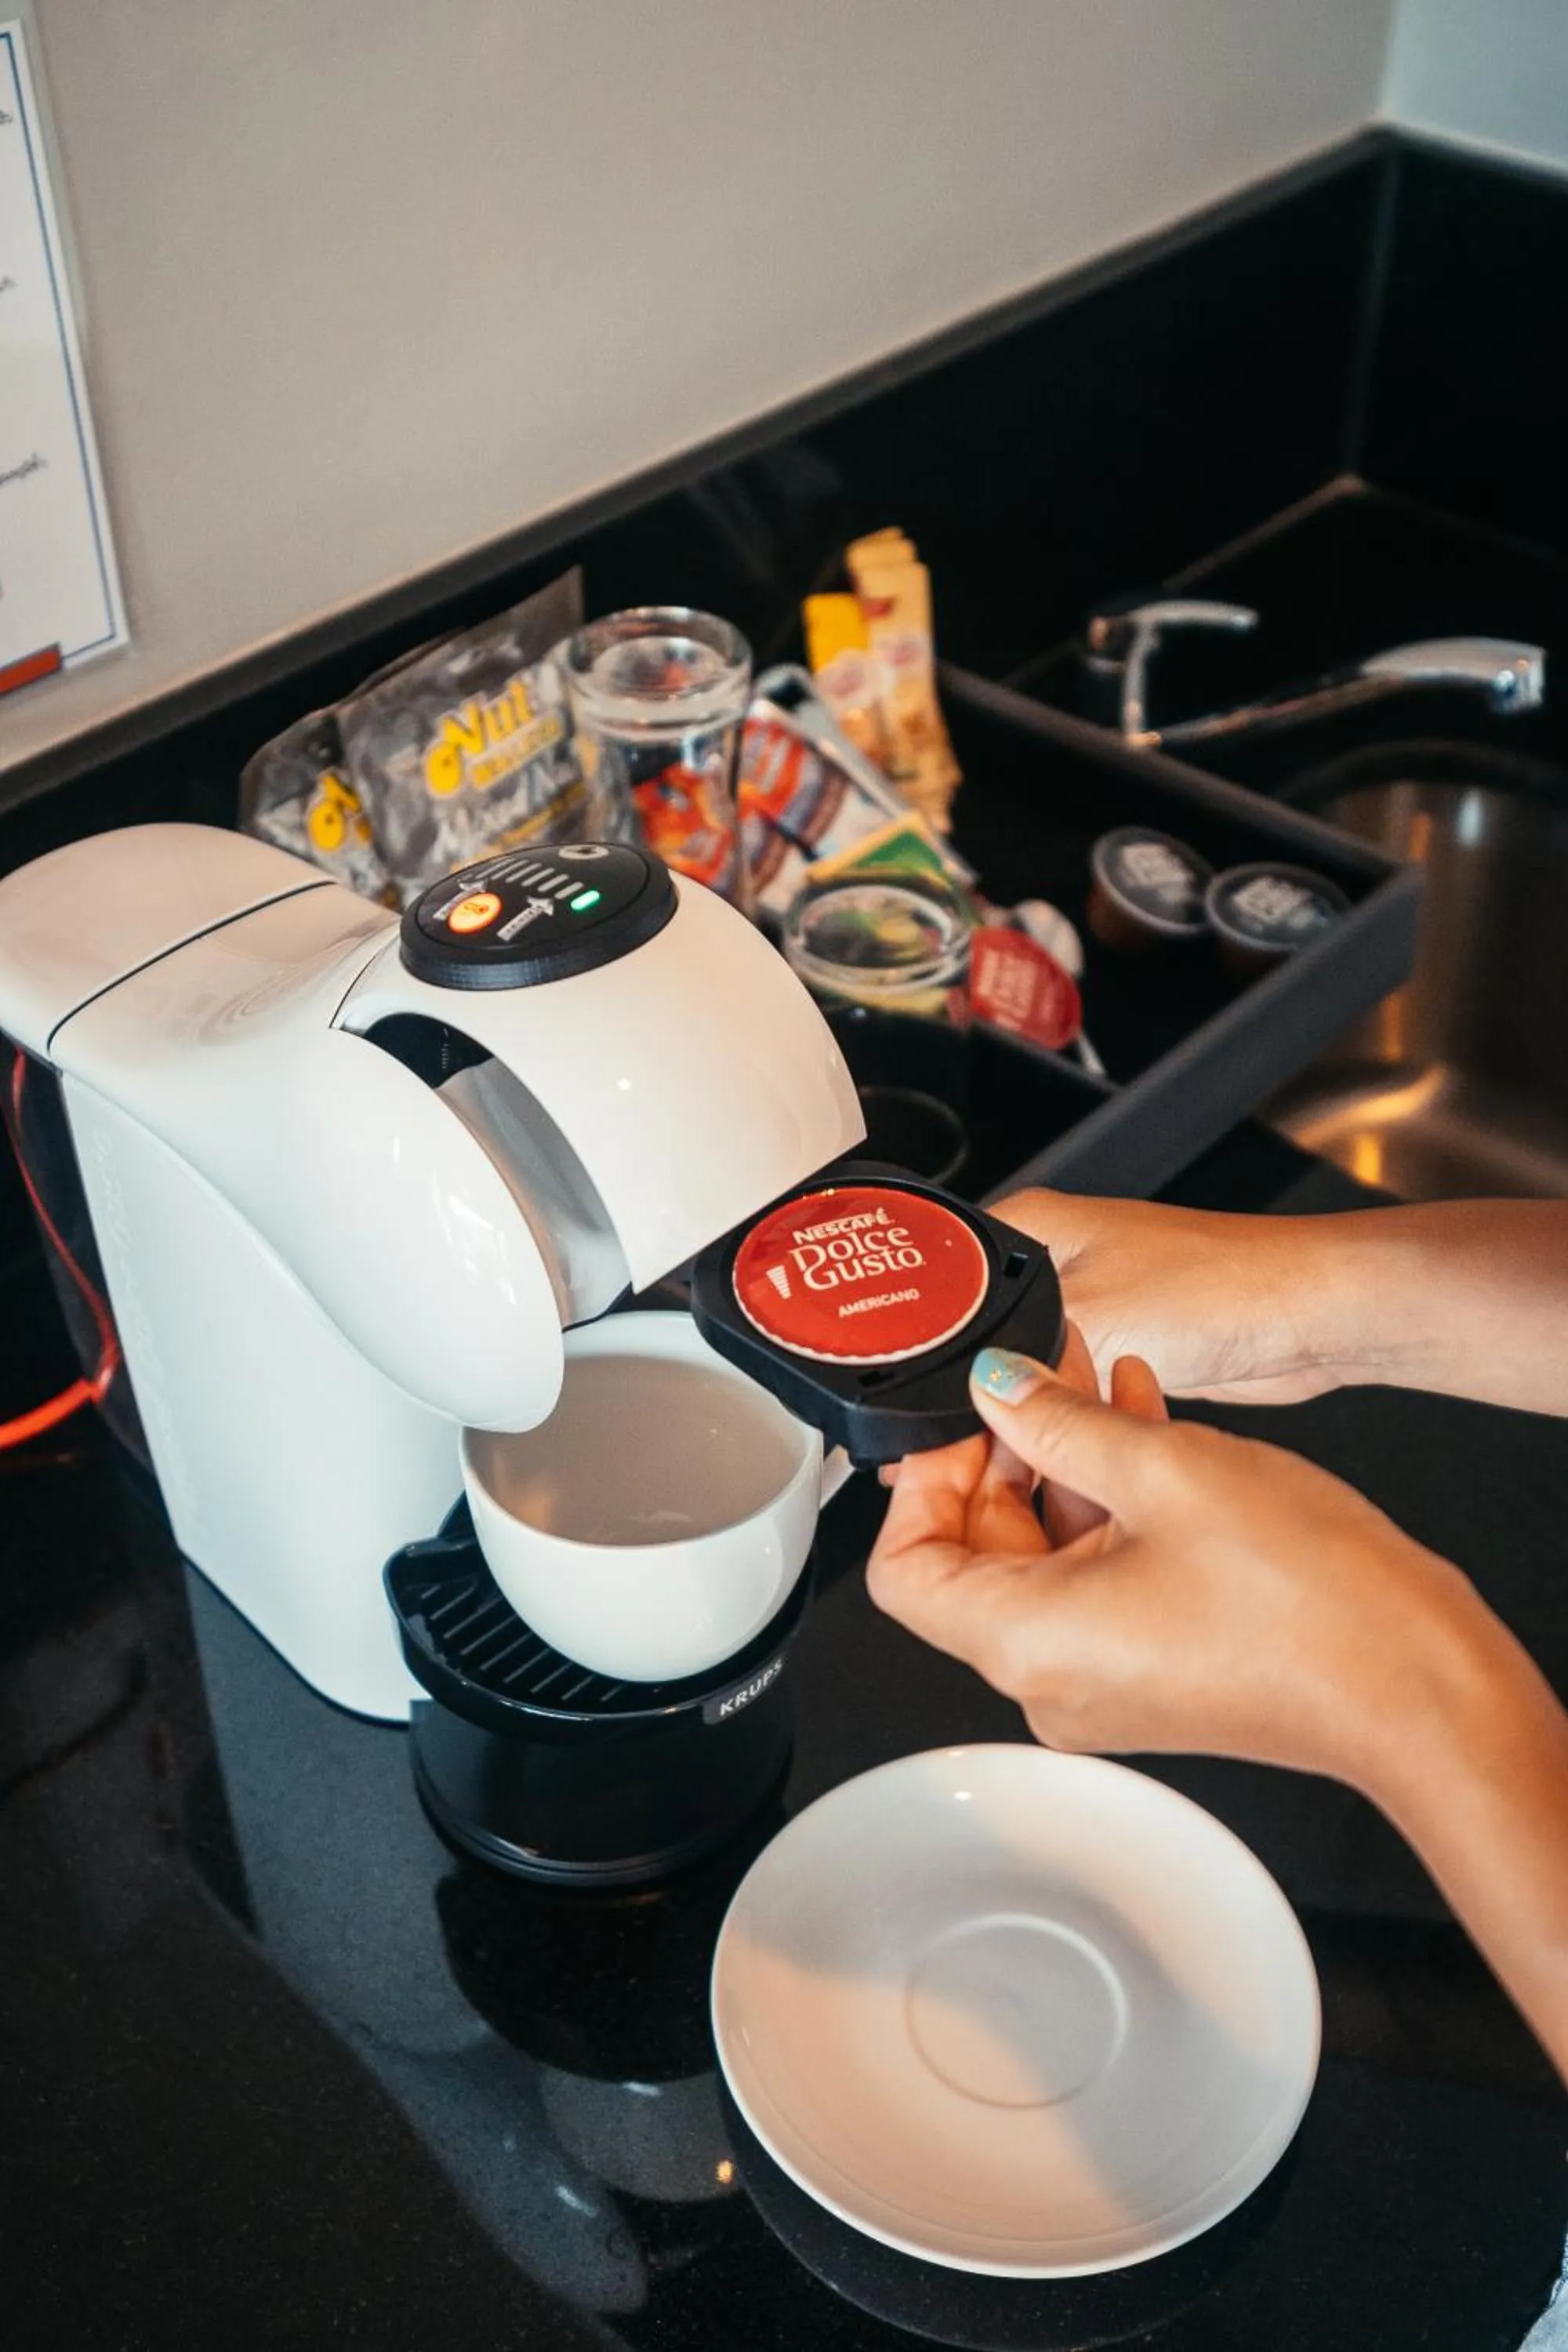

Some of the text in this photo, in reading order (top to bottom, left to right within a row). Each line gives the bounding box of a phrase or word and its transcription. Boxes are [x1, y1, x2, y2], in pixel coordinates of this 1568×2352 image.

[792, 1207, 891, 1244] NESCAFÉ
[789, 1228, 913, 1272] Dolce
[837, 1288, 920, 1318] AMERICANO
